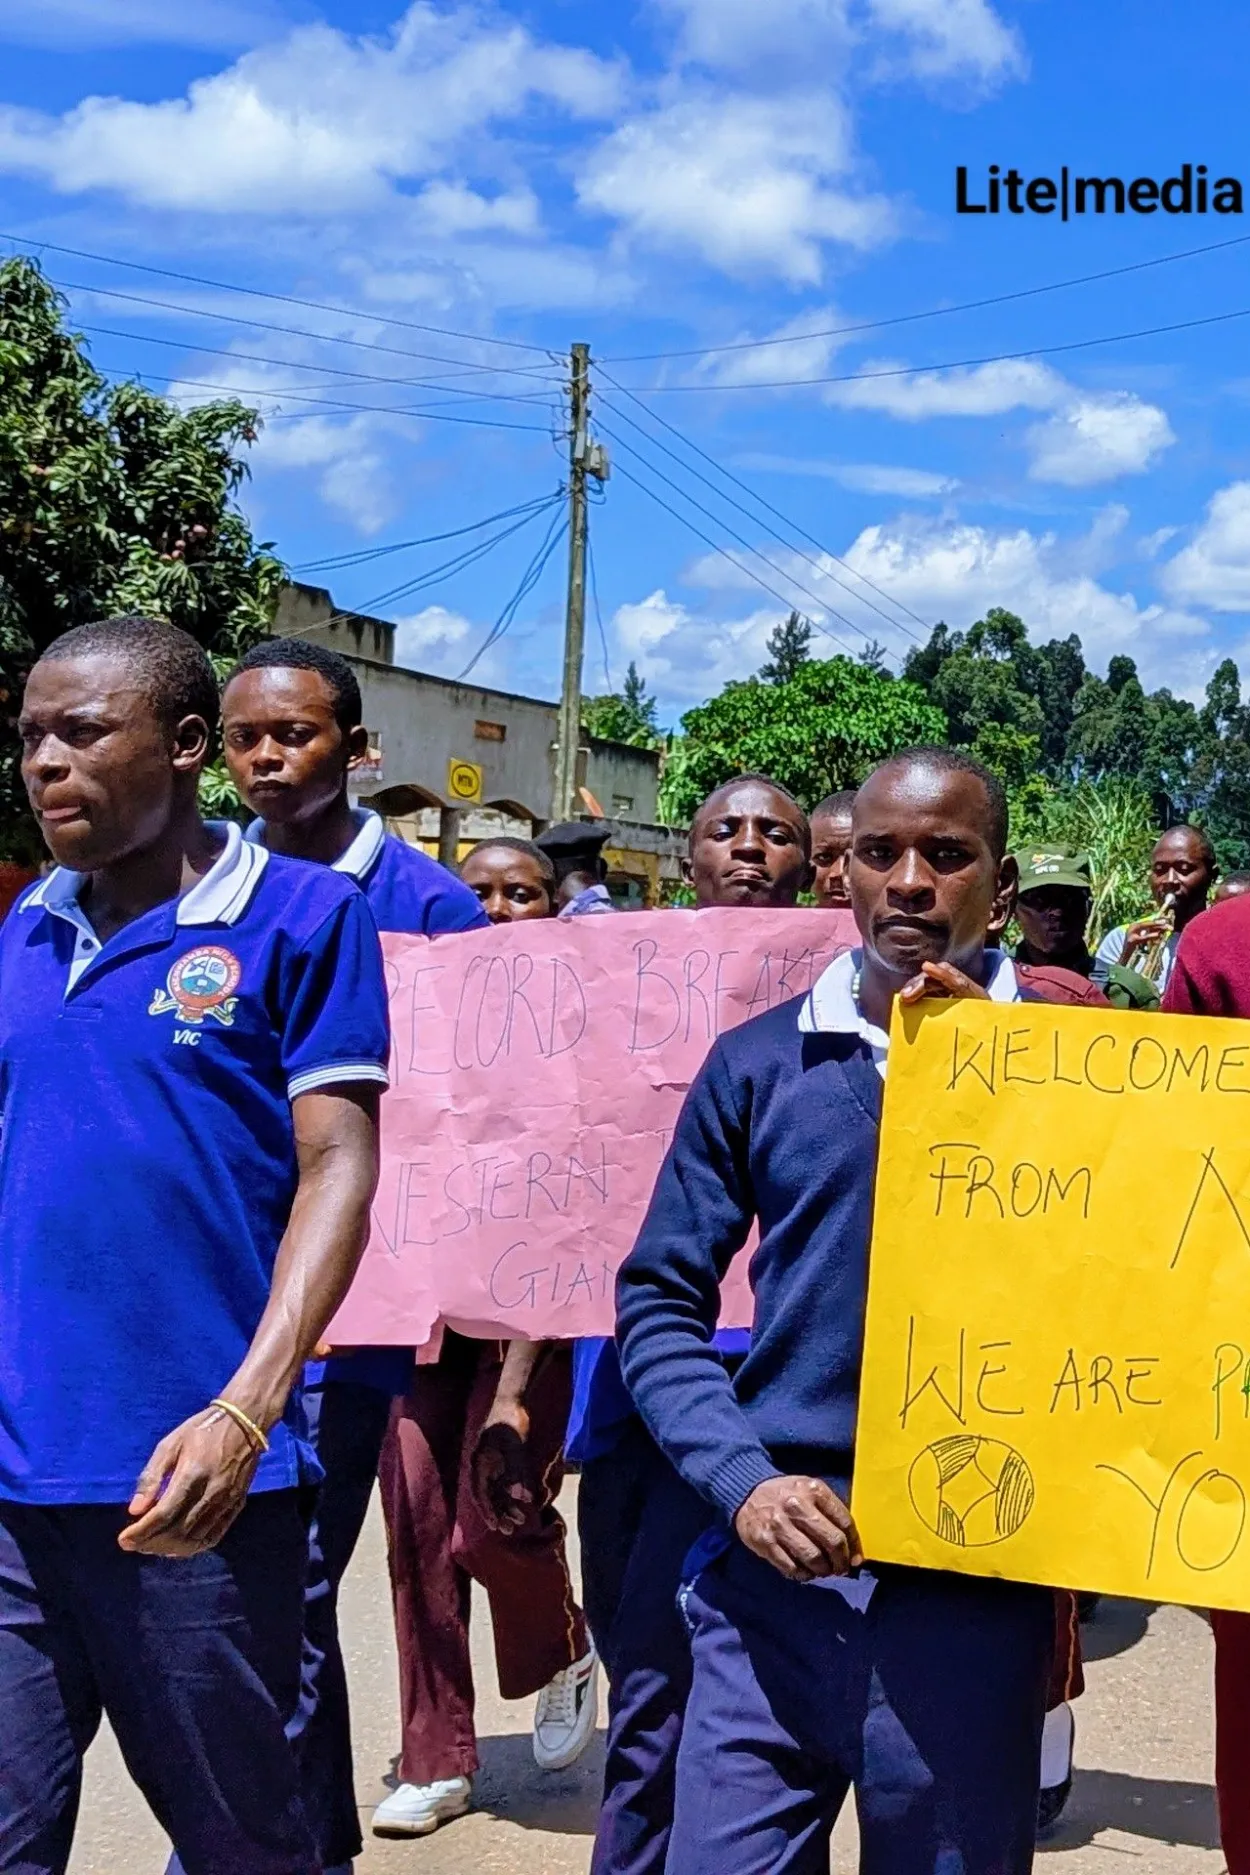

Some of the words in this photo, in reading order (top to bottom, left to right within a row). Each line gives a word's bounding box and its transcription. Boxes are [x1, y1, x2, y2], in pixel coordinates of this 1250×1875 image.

[172, 1029, 202, 1046] VIC
[627, 938, 854, 1054] BREAKE
[928, 1142, 1092, 1220] FROM
[898, 1315, 1025, 1430] WE
[1048, 1348, 1162, 1414] ARE
